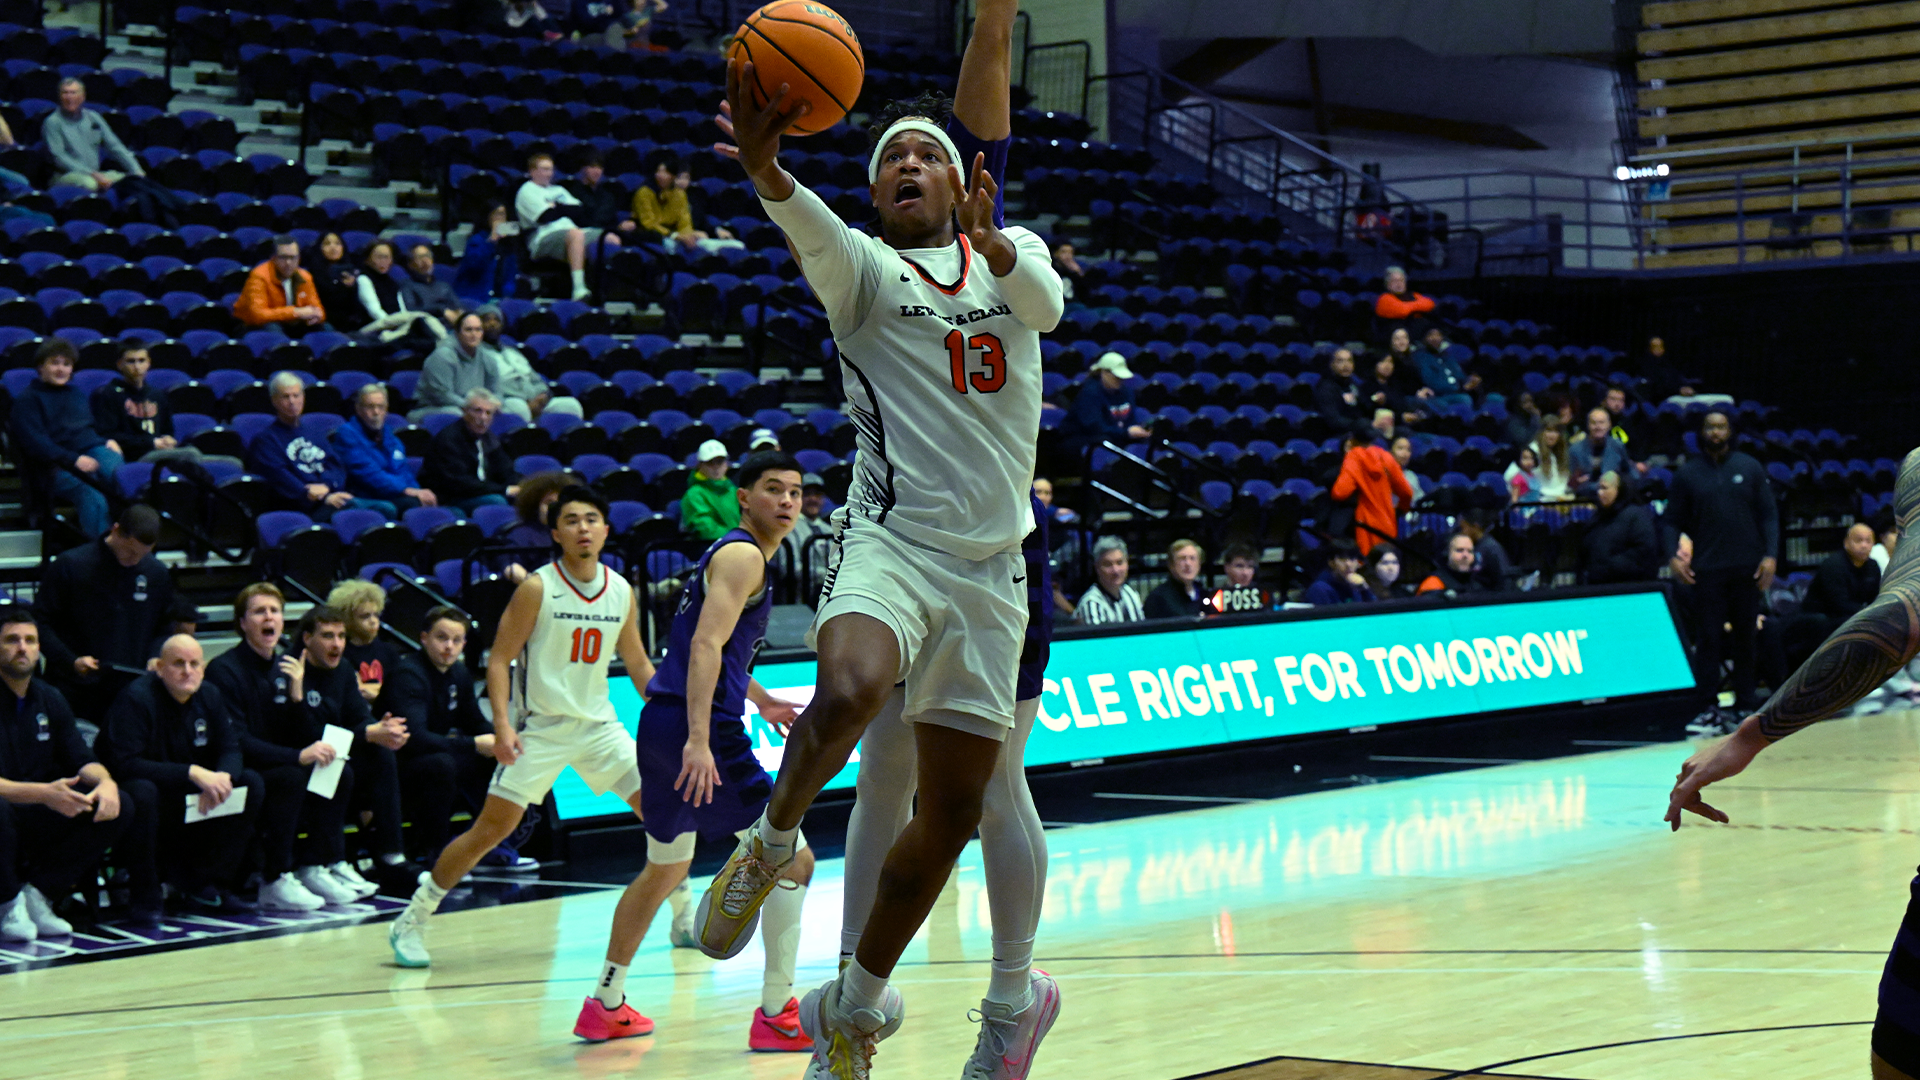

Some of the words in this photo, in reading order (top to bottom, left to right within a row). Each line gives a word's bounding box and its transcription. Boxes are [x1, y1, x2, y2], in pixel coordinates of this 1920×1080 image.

[955, 314, 969, 326] &
[944, 328, 1007, 395] 13
[553, 612, 582, 620] LEWIS
[592, 614, 620, 622] CLARK
[570, 627, 603, 664] 10
[1128, 659, 1275, 717] RIGHT,
[1273, 650, 1367, 705] FOR
